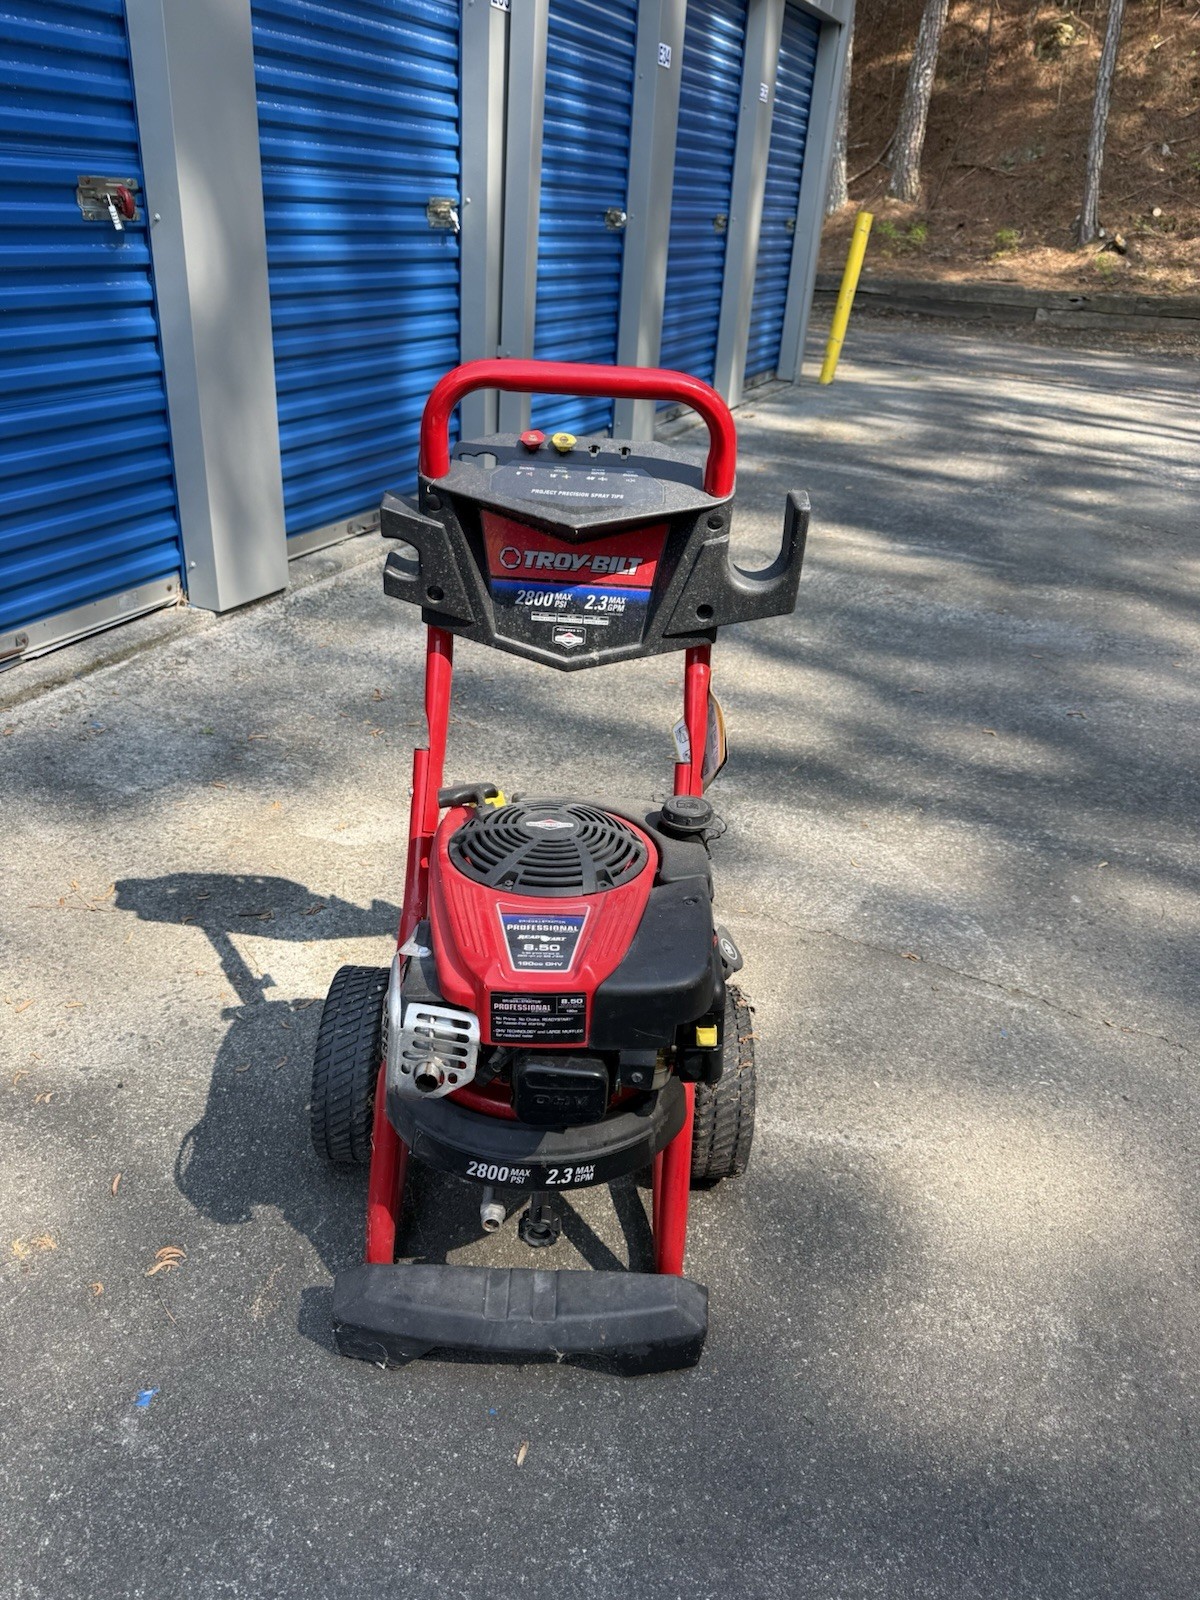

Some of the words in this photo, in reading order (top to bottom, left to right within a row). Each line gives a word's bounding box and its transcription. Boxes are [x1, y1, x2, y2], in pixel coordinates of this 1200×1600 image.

[531, 488, 557, 496] PROJECT
[558, 490, 589, 498] PRECISION
[523, 550, 644, 576] TROY-BILT
[515, 590, 554, 607] 2800
[554, 593, 573, 601] MAX
[608, 596, 627, 605] MAX
[554, 600, 567, 608] PSI
[584, 595, 608, 611] 2.3
[607, 604, 625, 612] GPM
[506, 924, 579, 932] PROFESSIONAL
[493, 1003, 551, 1011] PROFESSIONAL
[466, 1161, 509, 1182] 2800
[510, 1168, 532, 1177] MAX
[575, 1164, 596, 1175] MAX
[510, 1176, 525, 1184] PSI
[545, 1167, 573, 1185] 2.3
[574, 1173, 594, 1183] GPM
